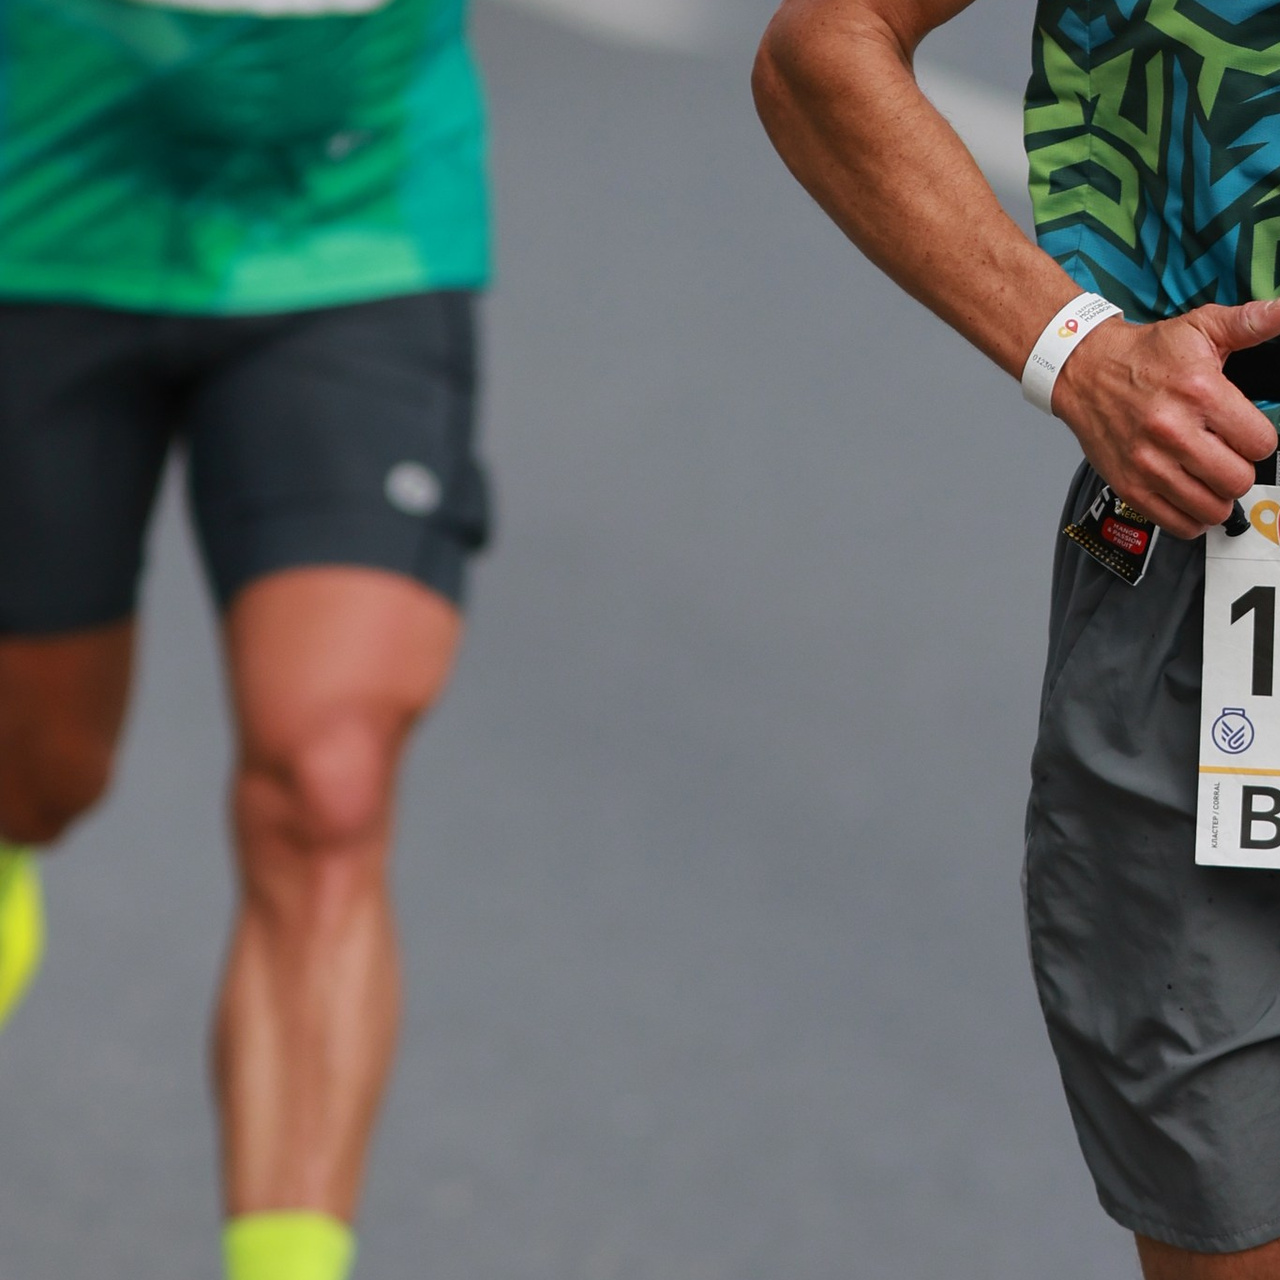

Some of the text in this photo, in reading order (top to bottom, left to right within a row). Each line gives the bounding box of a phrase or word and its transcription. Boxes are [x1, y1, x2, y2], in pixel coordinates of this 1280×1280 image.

[1120, 509, 1148, 524] NERGY
[1112, 529, 1142, 546] PASSION
[1113, 523, 1139, 538] MANGO
[1113, 537, 1133, 550] FRUIT
[1212, 782, 1221, 810] CORRAL
[1211, 816, 1220, 849] КЛАСТЕР
